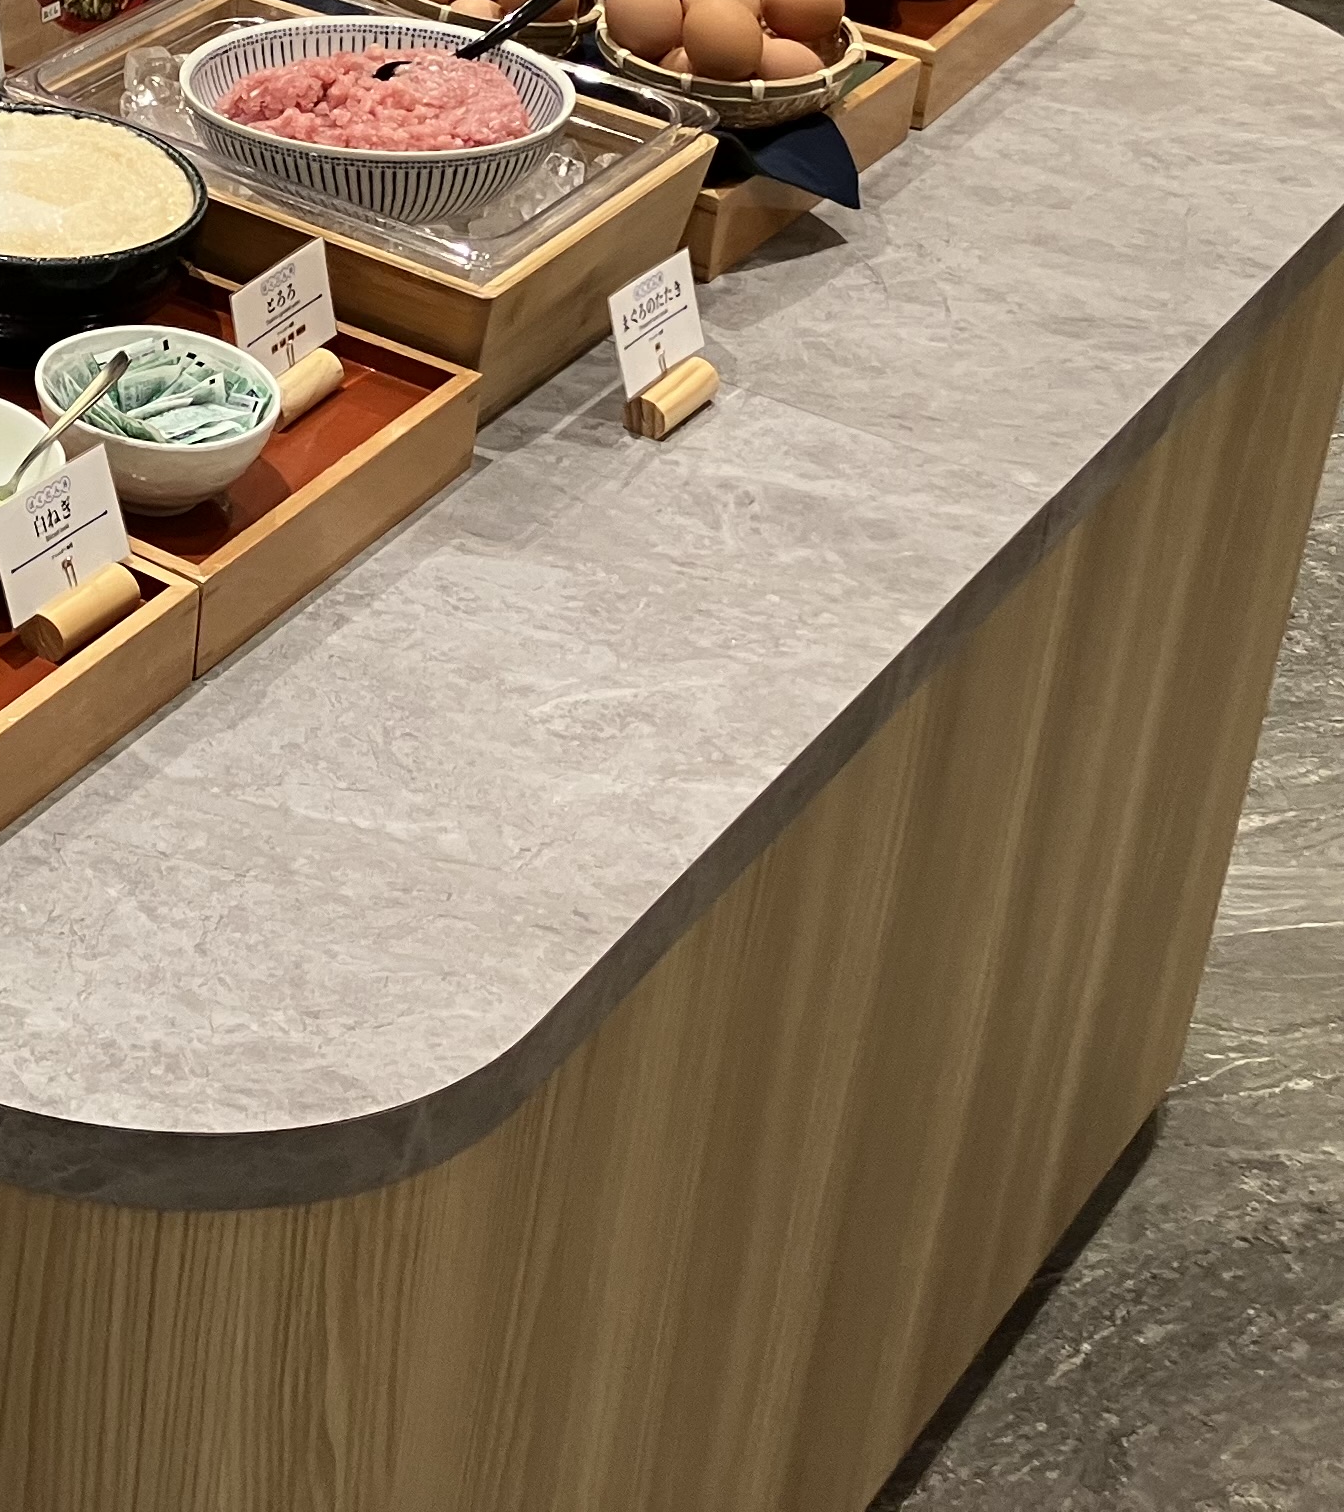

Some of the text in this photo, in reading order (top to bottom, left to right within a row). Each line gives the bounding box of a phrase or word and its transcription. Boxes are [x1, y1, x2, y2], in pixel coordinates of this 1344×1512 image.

[266, 283, 296, 314] とろろ
[622, 279, 682, 334] まぐろのたたき
[33, 495, 72, 538] 白ねぎ
